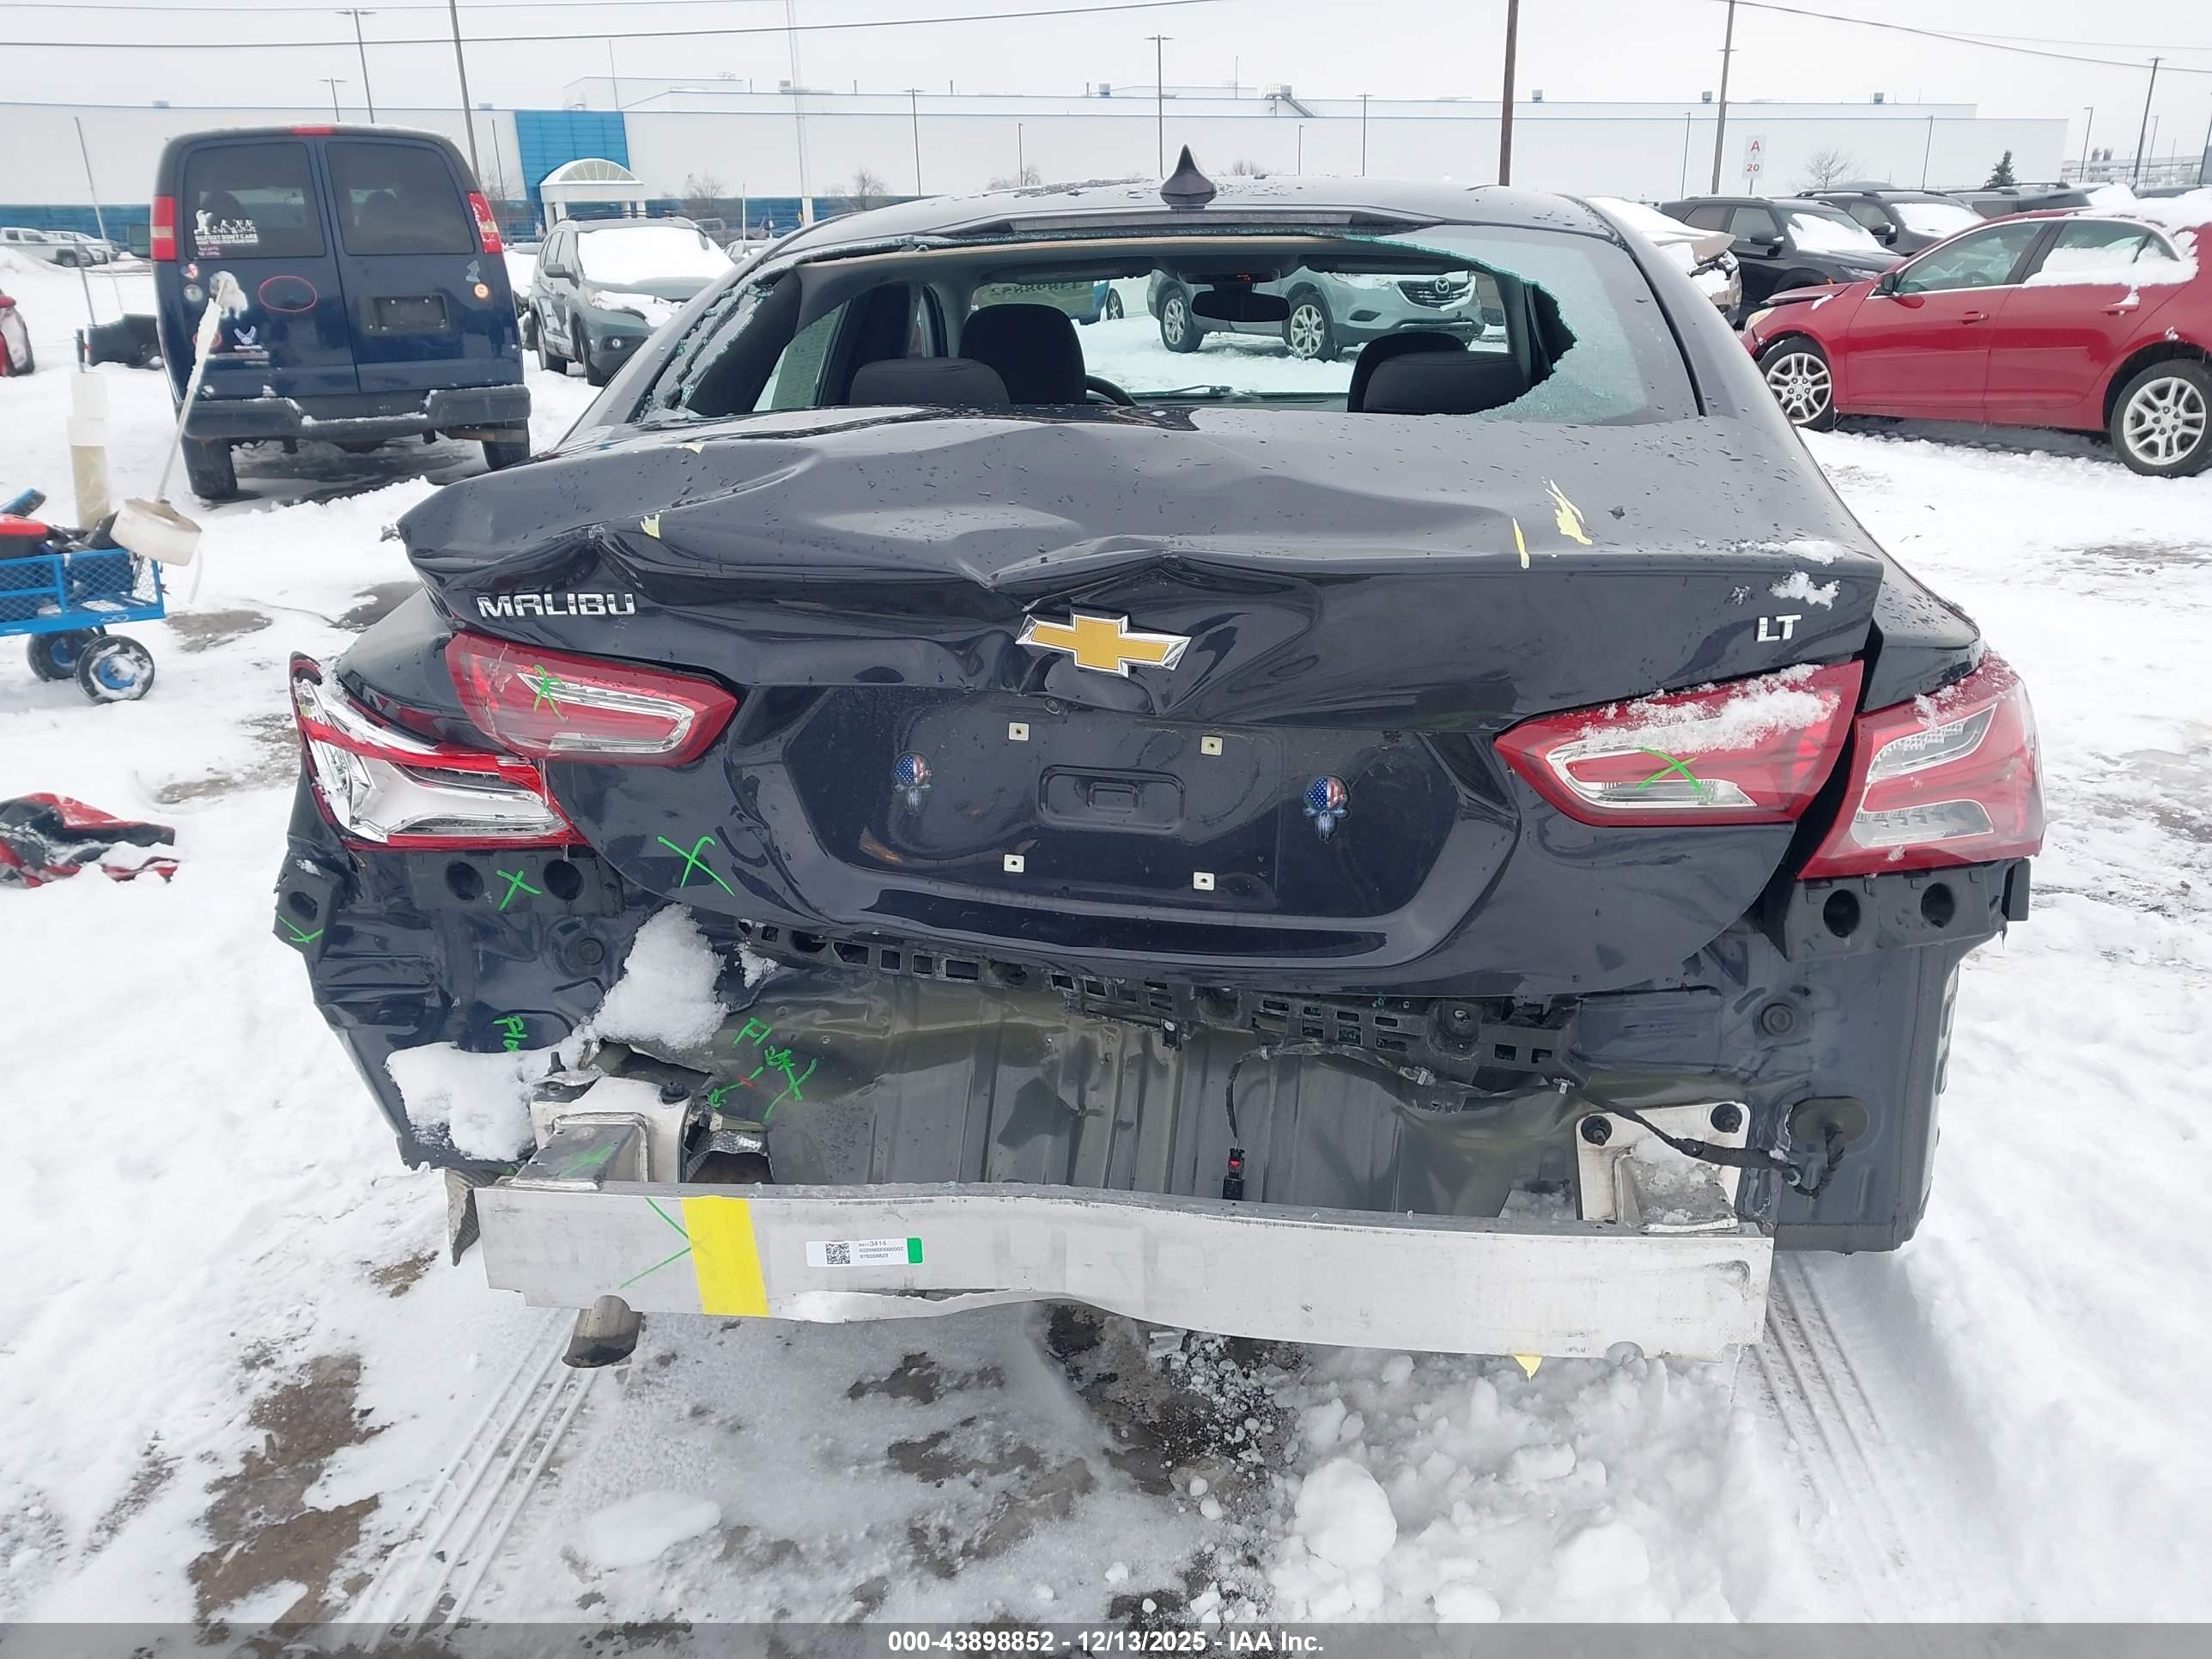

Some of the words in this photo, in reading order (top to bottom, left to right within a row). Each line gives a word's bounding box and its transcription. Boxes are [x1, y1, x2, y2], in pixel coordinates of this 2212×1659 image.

[1750, 140, 1760, 152] A
[1747, 163, 1760, 172] 20
[476, 592, 636, 618] MALIBU
[1757, 613, 1802, 643] LT
